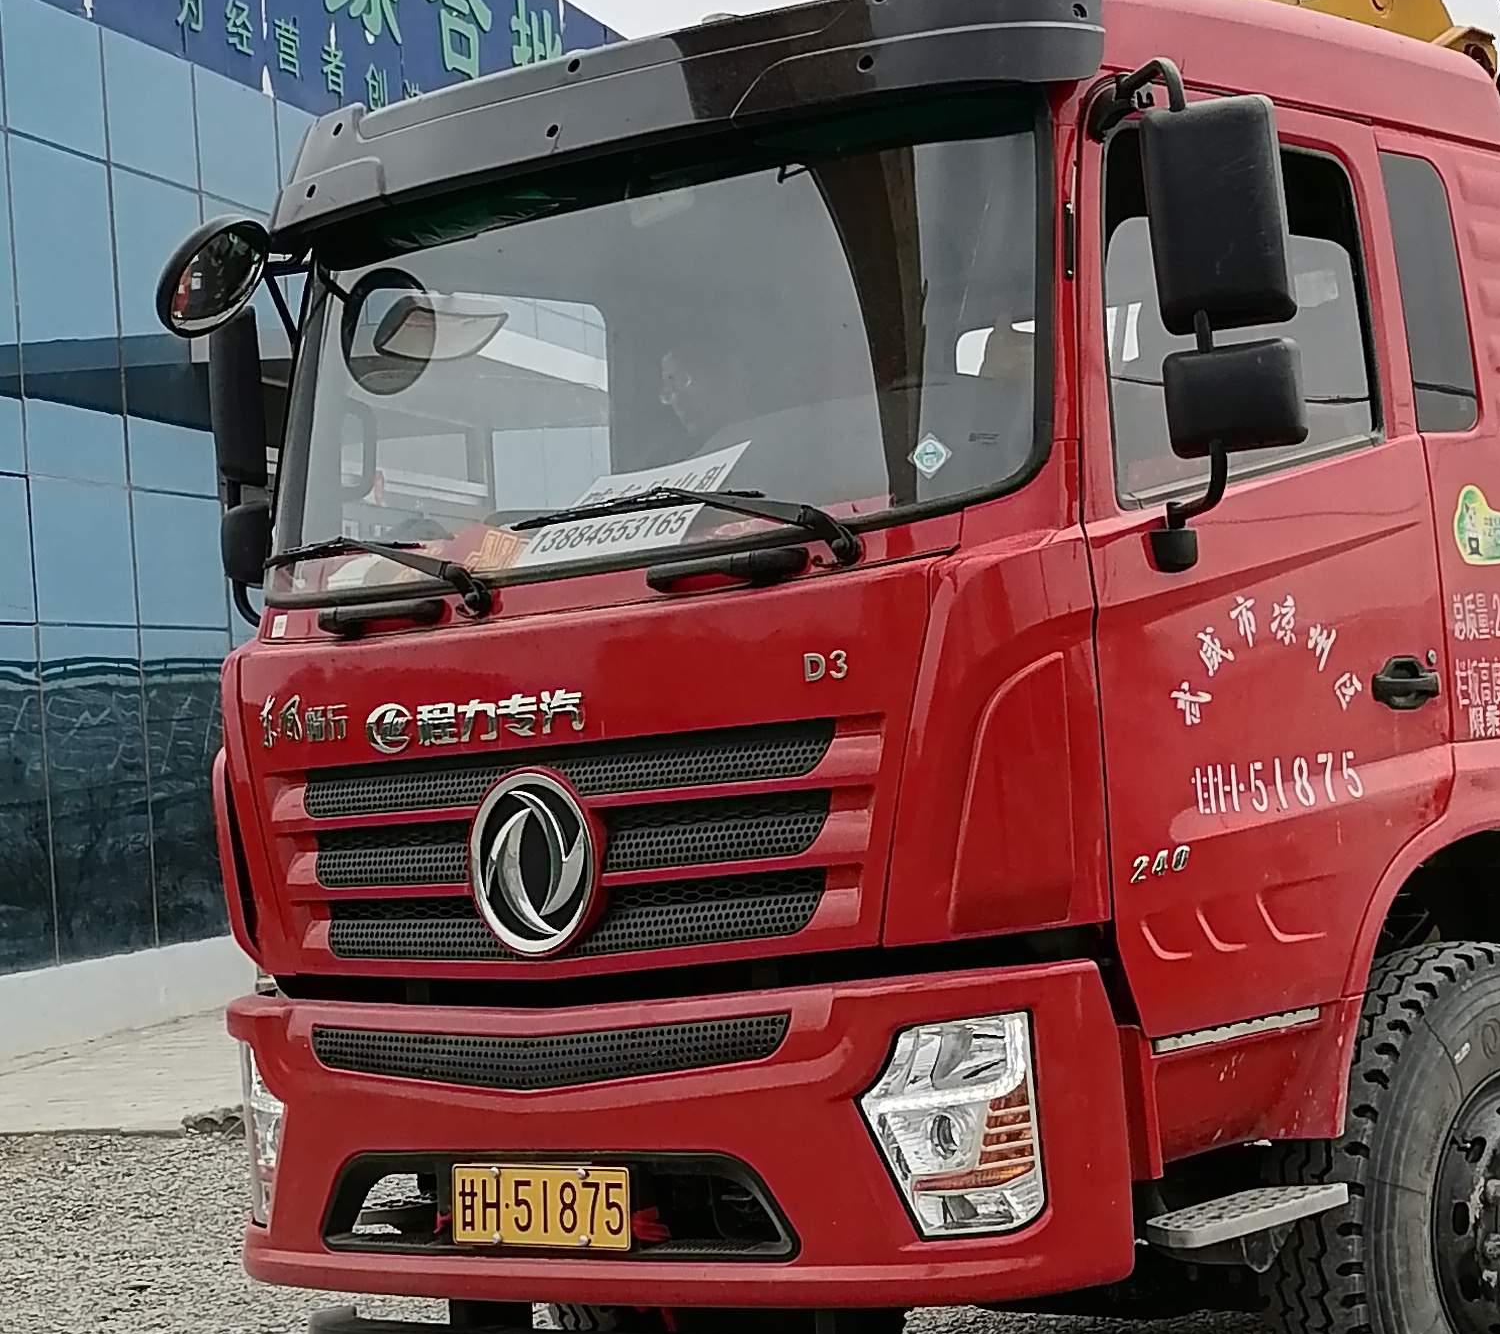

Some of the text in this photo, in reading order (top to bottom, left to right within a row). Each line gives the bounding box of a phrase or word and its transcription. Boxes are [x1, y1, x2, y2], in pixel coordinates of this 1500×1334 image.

[530, 508, 694, 555] 13884553165
[803, 649, 848, 682] D3
[1170, 594, 1363, 726] 武威市凉州区
[416, 688, 586, 747] 程力专汽
[1130, 845, 1191, 884] 240
